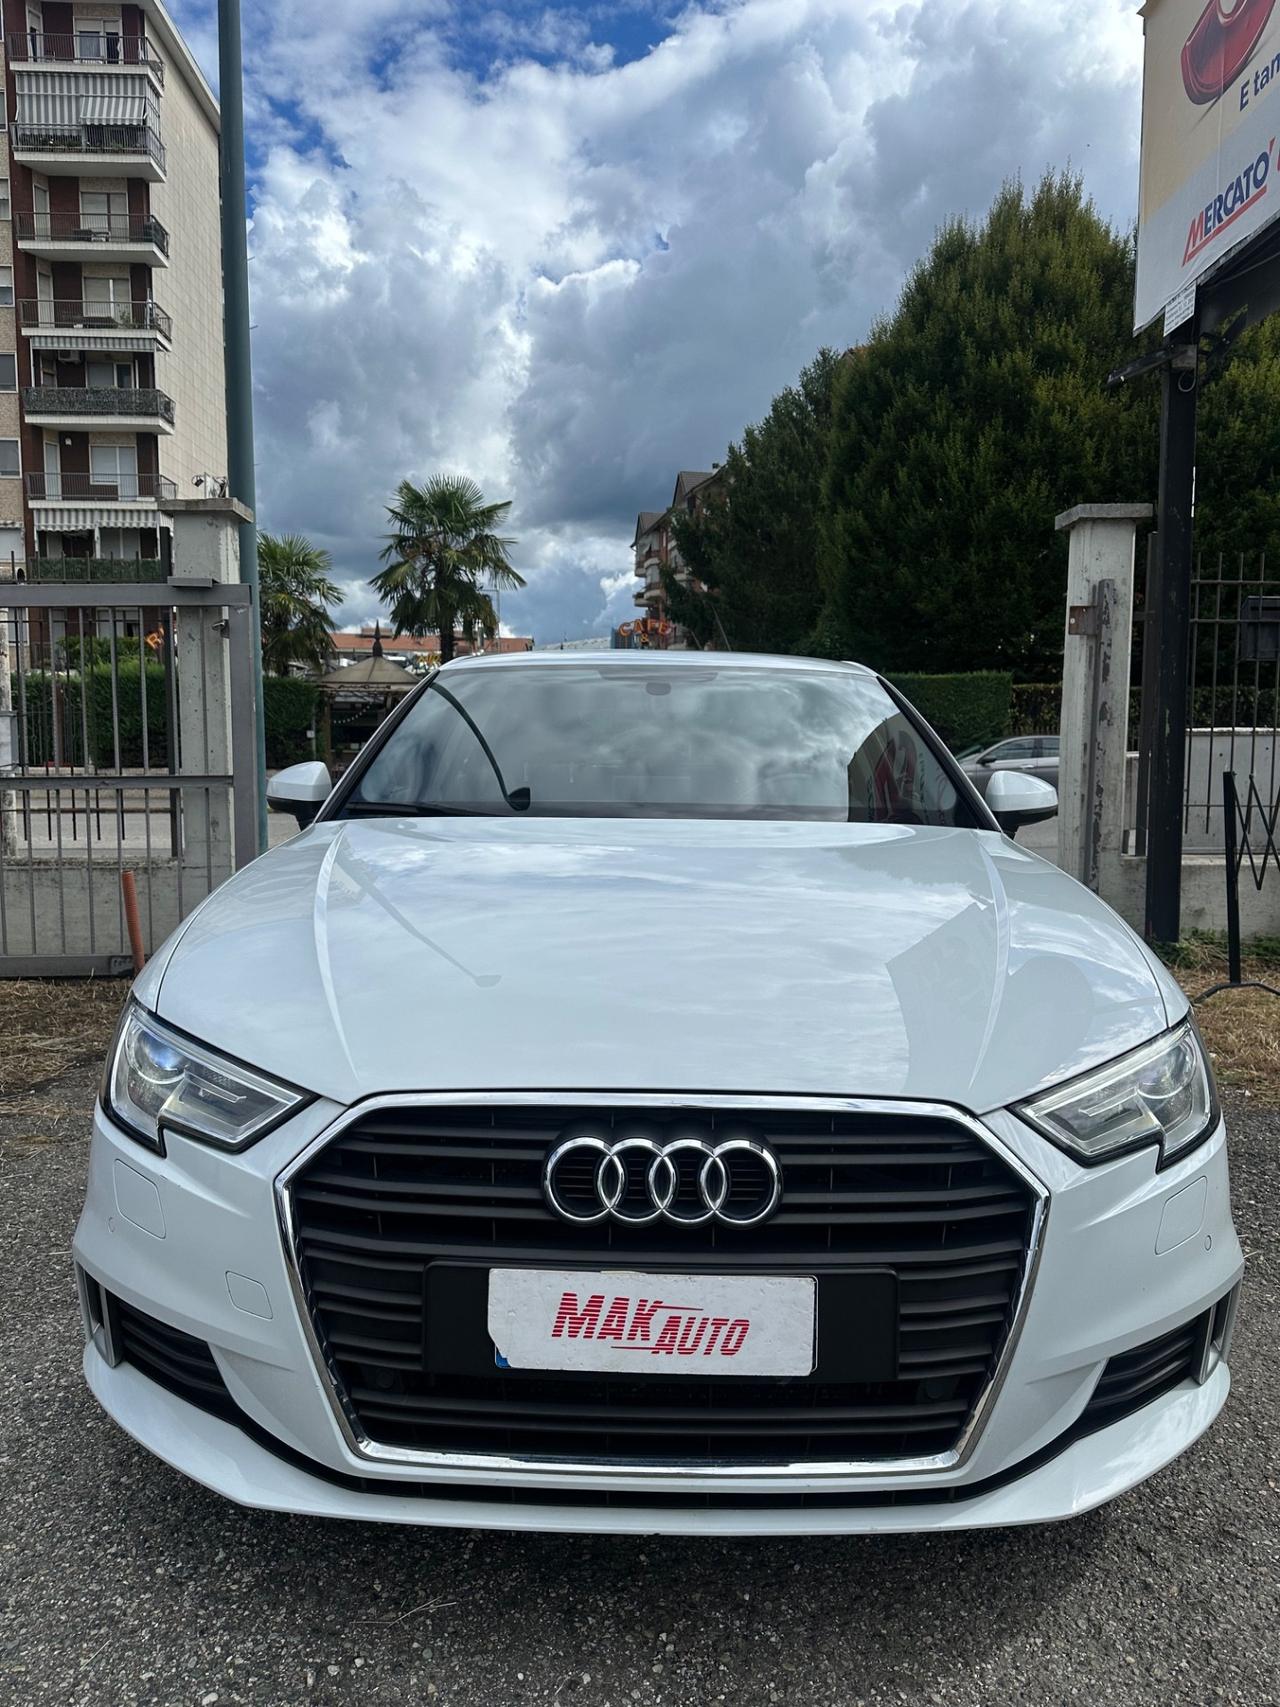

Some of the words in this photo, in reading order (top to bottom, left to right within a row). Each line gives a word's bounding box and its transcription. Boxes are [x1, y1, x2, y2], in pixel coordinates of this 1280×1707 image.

[1240, 79, 1250, 112] E
[551, 1292, 663, 1341] MAK
[651, 1315, 750, 1356] AUTO
